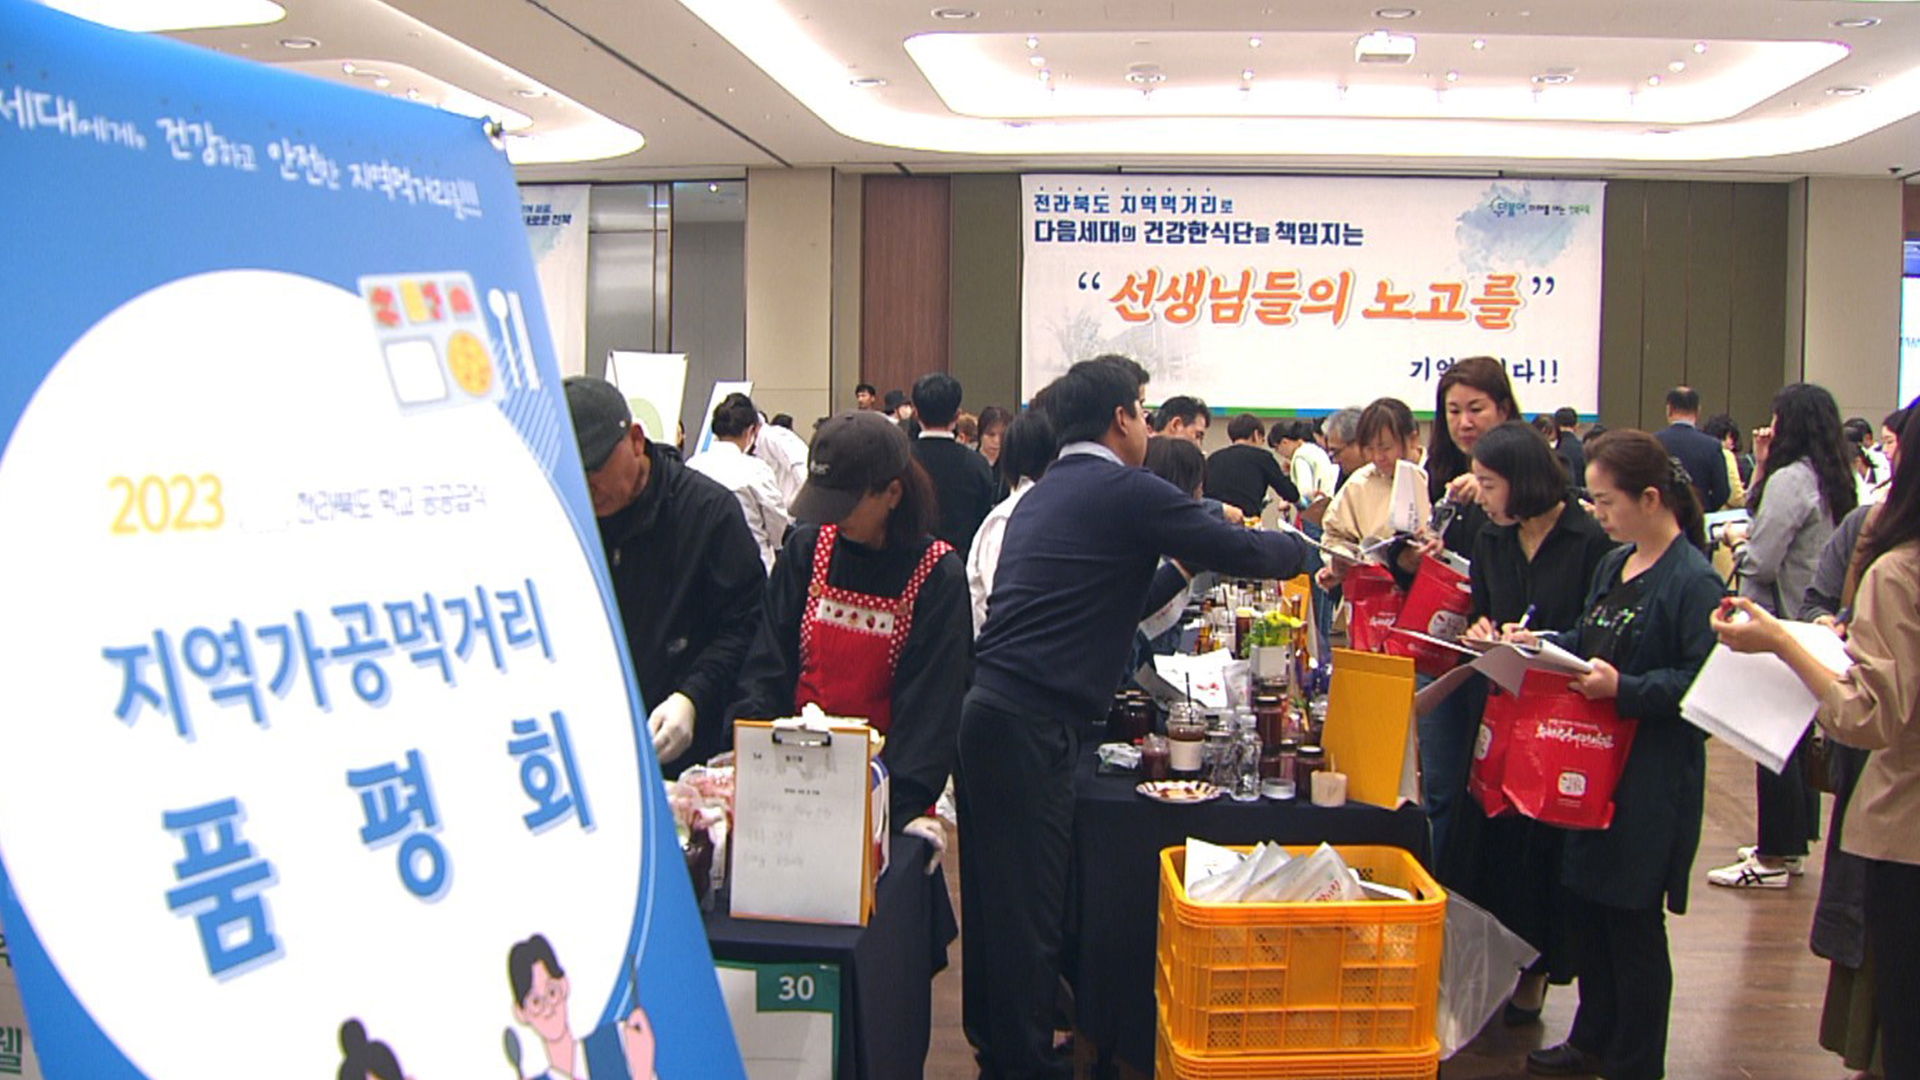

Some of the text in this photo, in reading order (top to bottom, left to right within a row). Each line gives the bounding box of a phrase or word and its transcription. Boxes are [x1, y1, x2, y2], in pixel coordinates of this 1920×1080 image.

[156, 116, 258, 171] 건강하고
[267, 137, 341, 190] 안전한
[1034, 194, 1234, 214] 전라북도 지역먹거리로
[1034, 220, 1364, 246] 다음세대의 건강한식단을 책임지는
[108, 472, 225, 536] 2023
[102, 578, 555, 741] 지역가공먹거리
[778, 976, 815, 1000] 30
